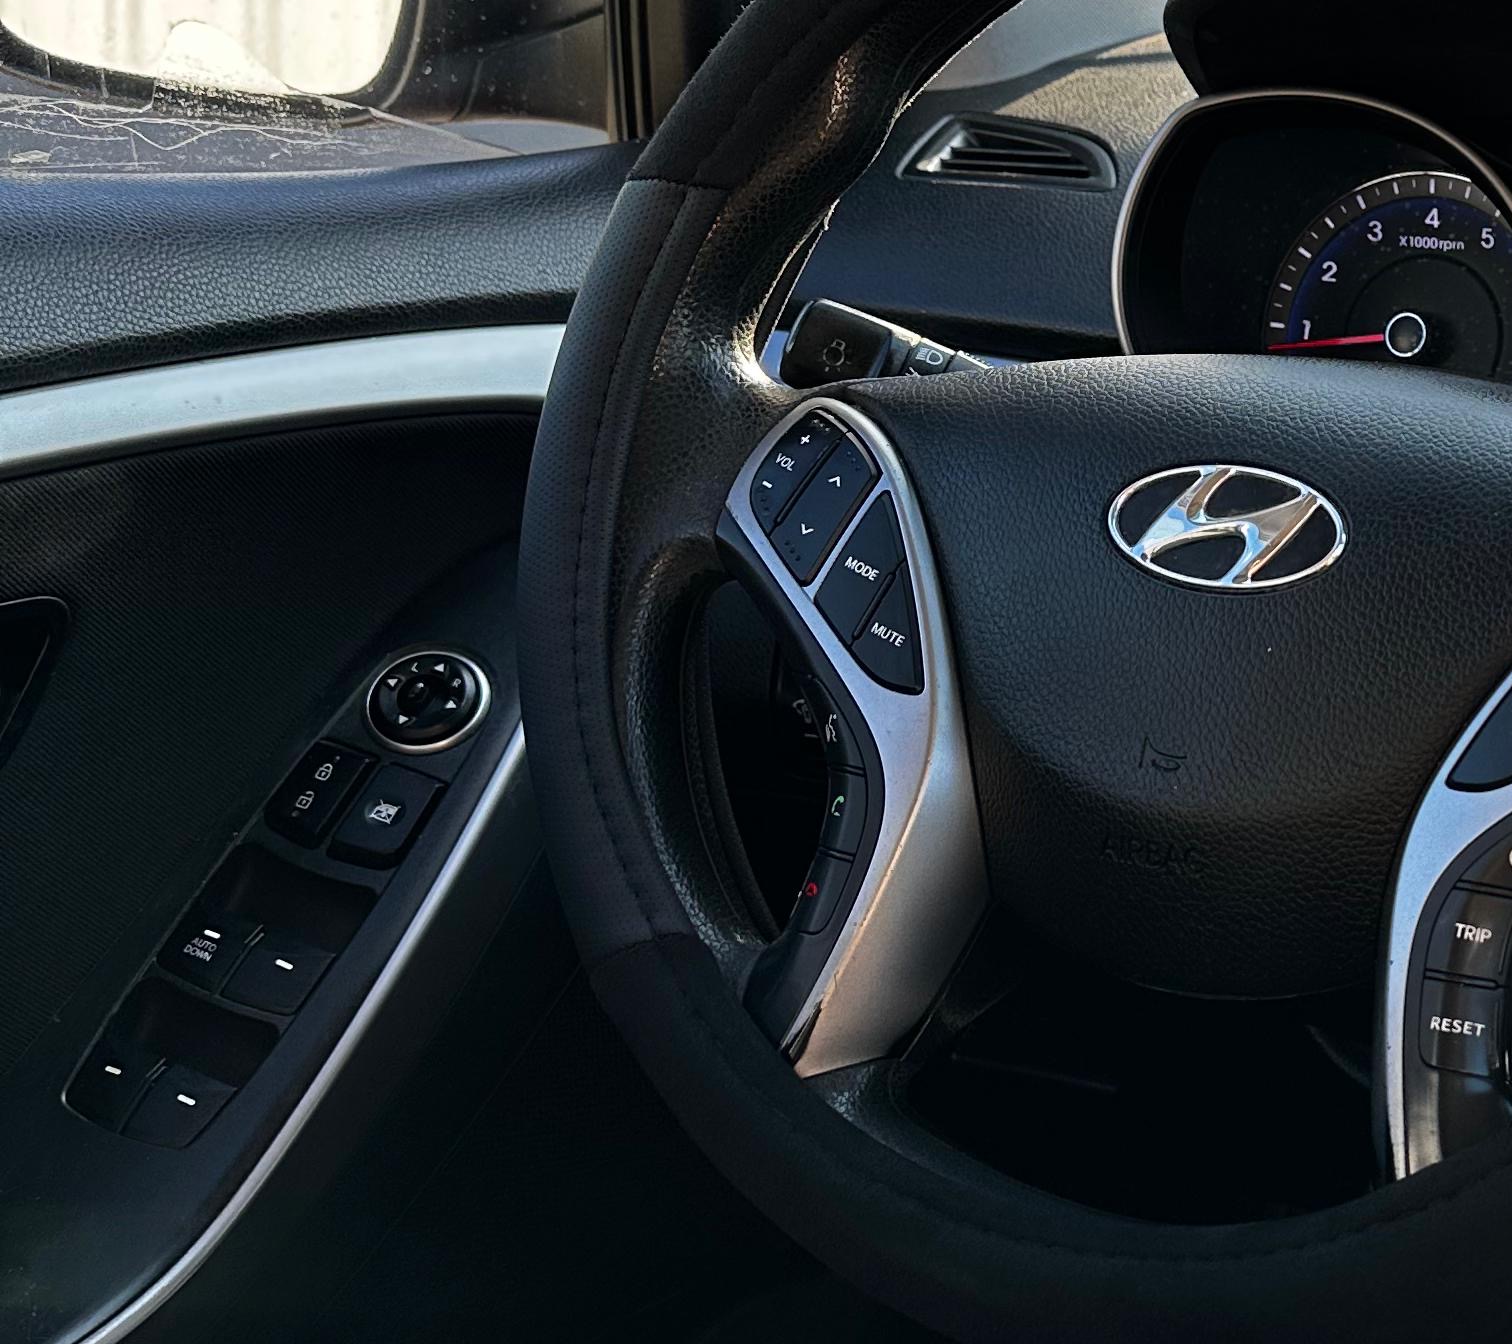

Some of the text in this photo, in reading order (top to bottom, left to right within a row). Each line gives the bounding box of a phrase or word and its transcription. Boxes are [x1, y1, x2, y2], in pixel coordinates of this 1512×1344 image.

[1424, 208, 1440, 229] 4
[1367, 220, 1383, 242] 3
[1481, 227, 1495, 249] 5
[1321, 260, 1337, 283] 2
[1302, 320, 1311, 340] 1
[774, 453, 796, 472] VOL
[844, 556, 881, 582] MODE
[870, 622, 906, 648] MUTE
[452, 678, 462, 688] R
[1455, 922, 1493, 943] TRIP
[183, 944, 213, 962] DOWN
[191, 937, 218, 953] AUTO
[1430, 1016, 1486, 1037] RESET
